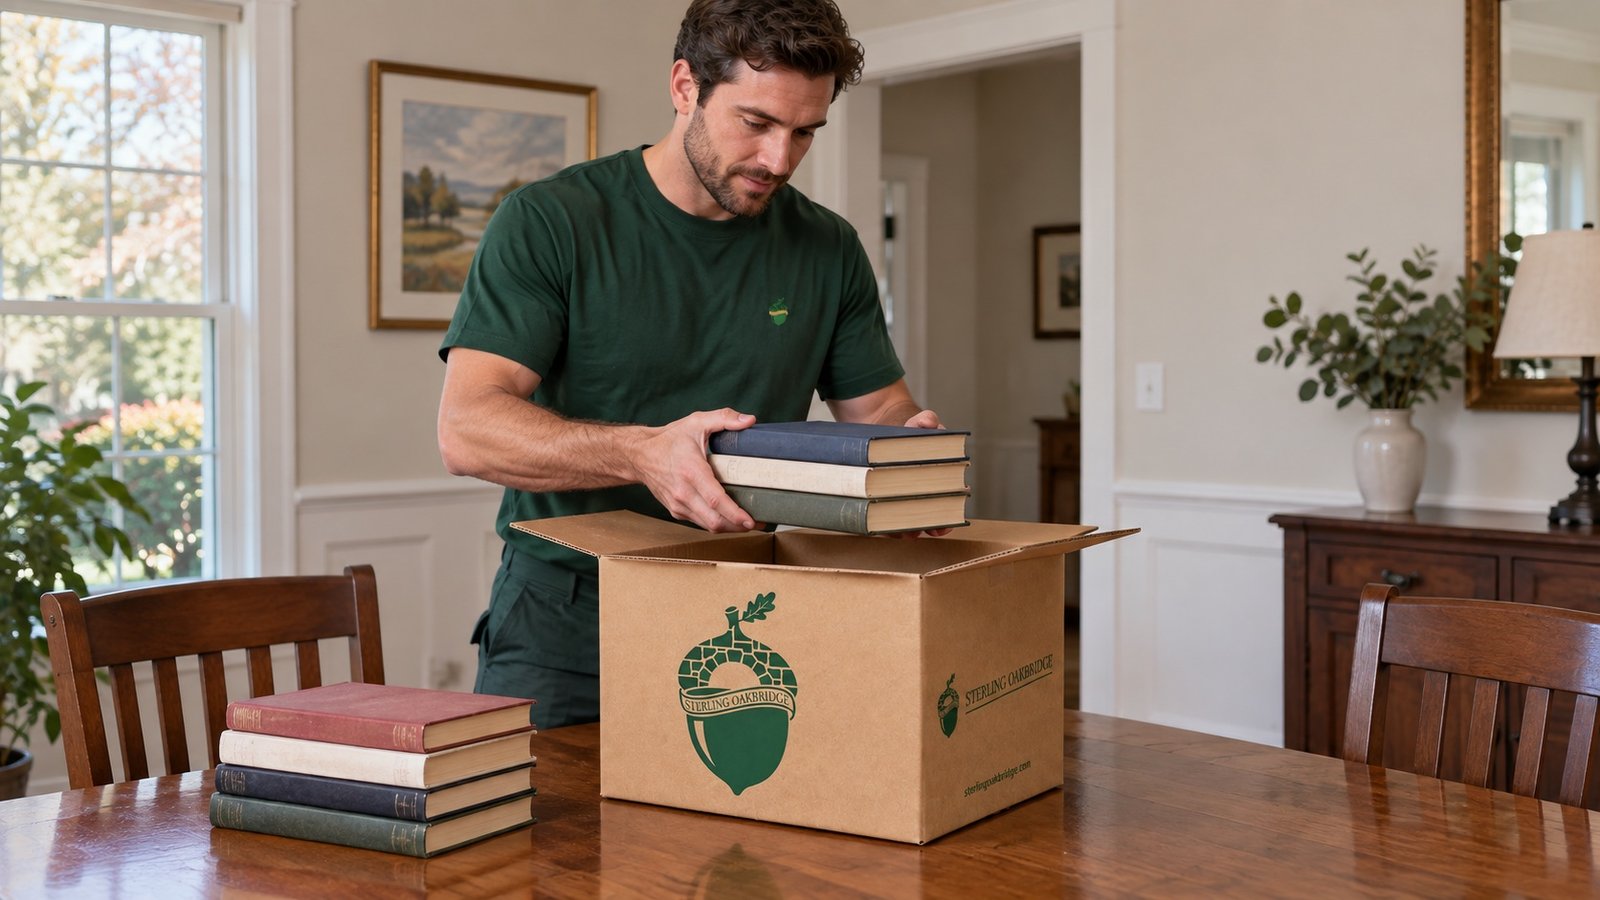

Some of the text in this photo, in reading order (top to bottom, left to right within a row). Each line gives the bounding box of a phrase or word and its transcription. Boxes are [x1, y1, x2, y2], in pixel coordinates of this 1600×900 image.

[965, 654, 1053, 707] STERLING OAKBRIDGE
[684, 691, 789, 712] STERLING OAKBRIDGE
